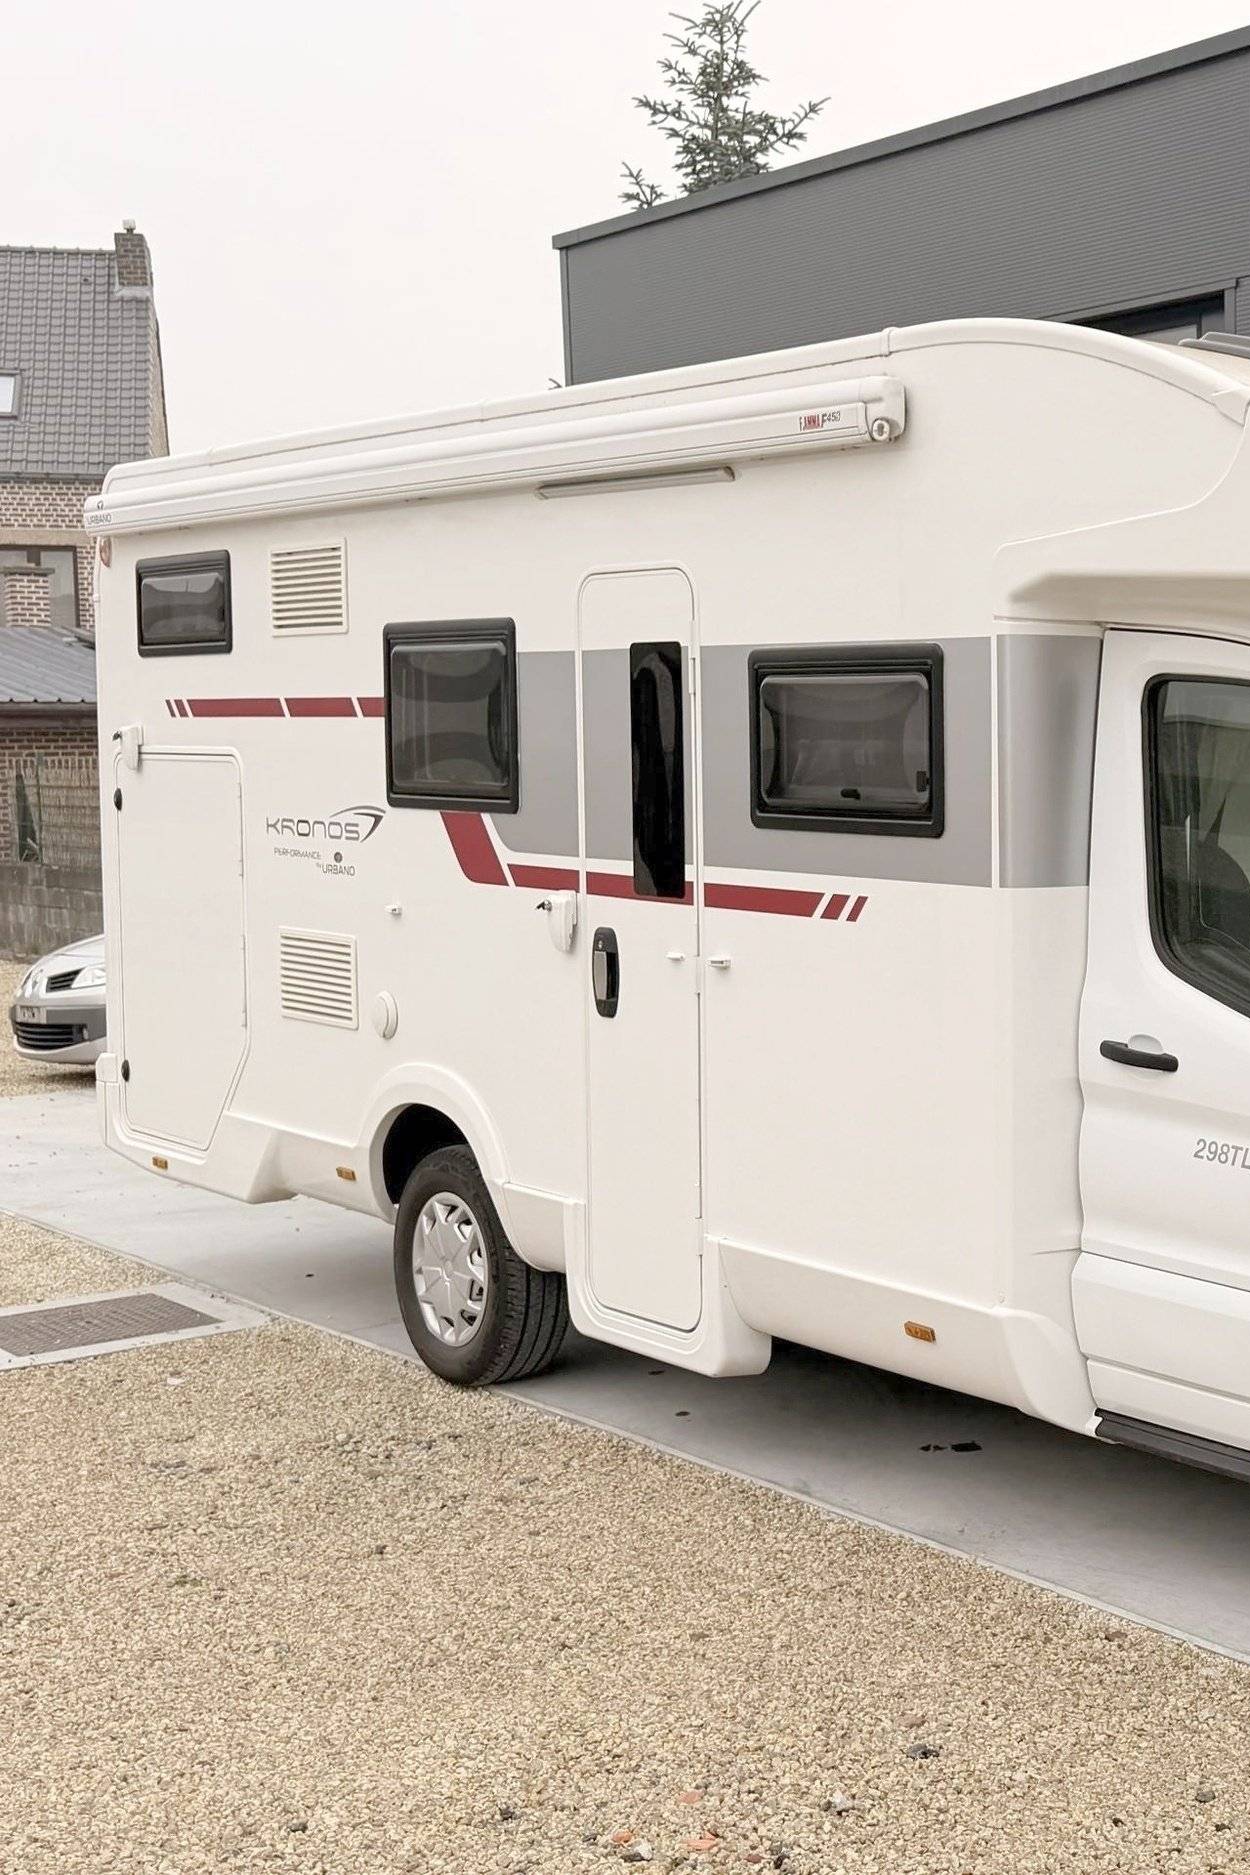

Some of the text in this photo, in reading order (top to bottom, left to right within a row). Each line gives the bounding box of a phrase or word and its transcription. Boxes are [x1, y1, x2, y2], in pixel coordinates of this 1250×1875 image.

[266, 817, 360, 841] KRONOS
[273, 847, 321, 860] PERFORMANCE
[321, 864, 356, 877] URBANO
